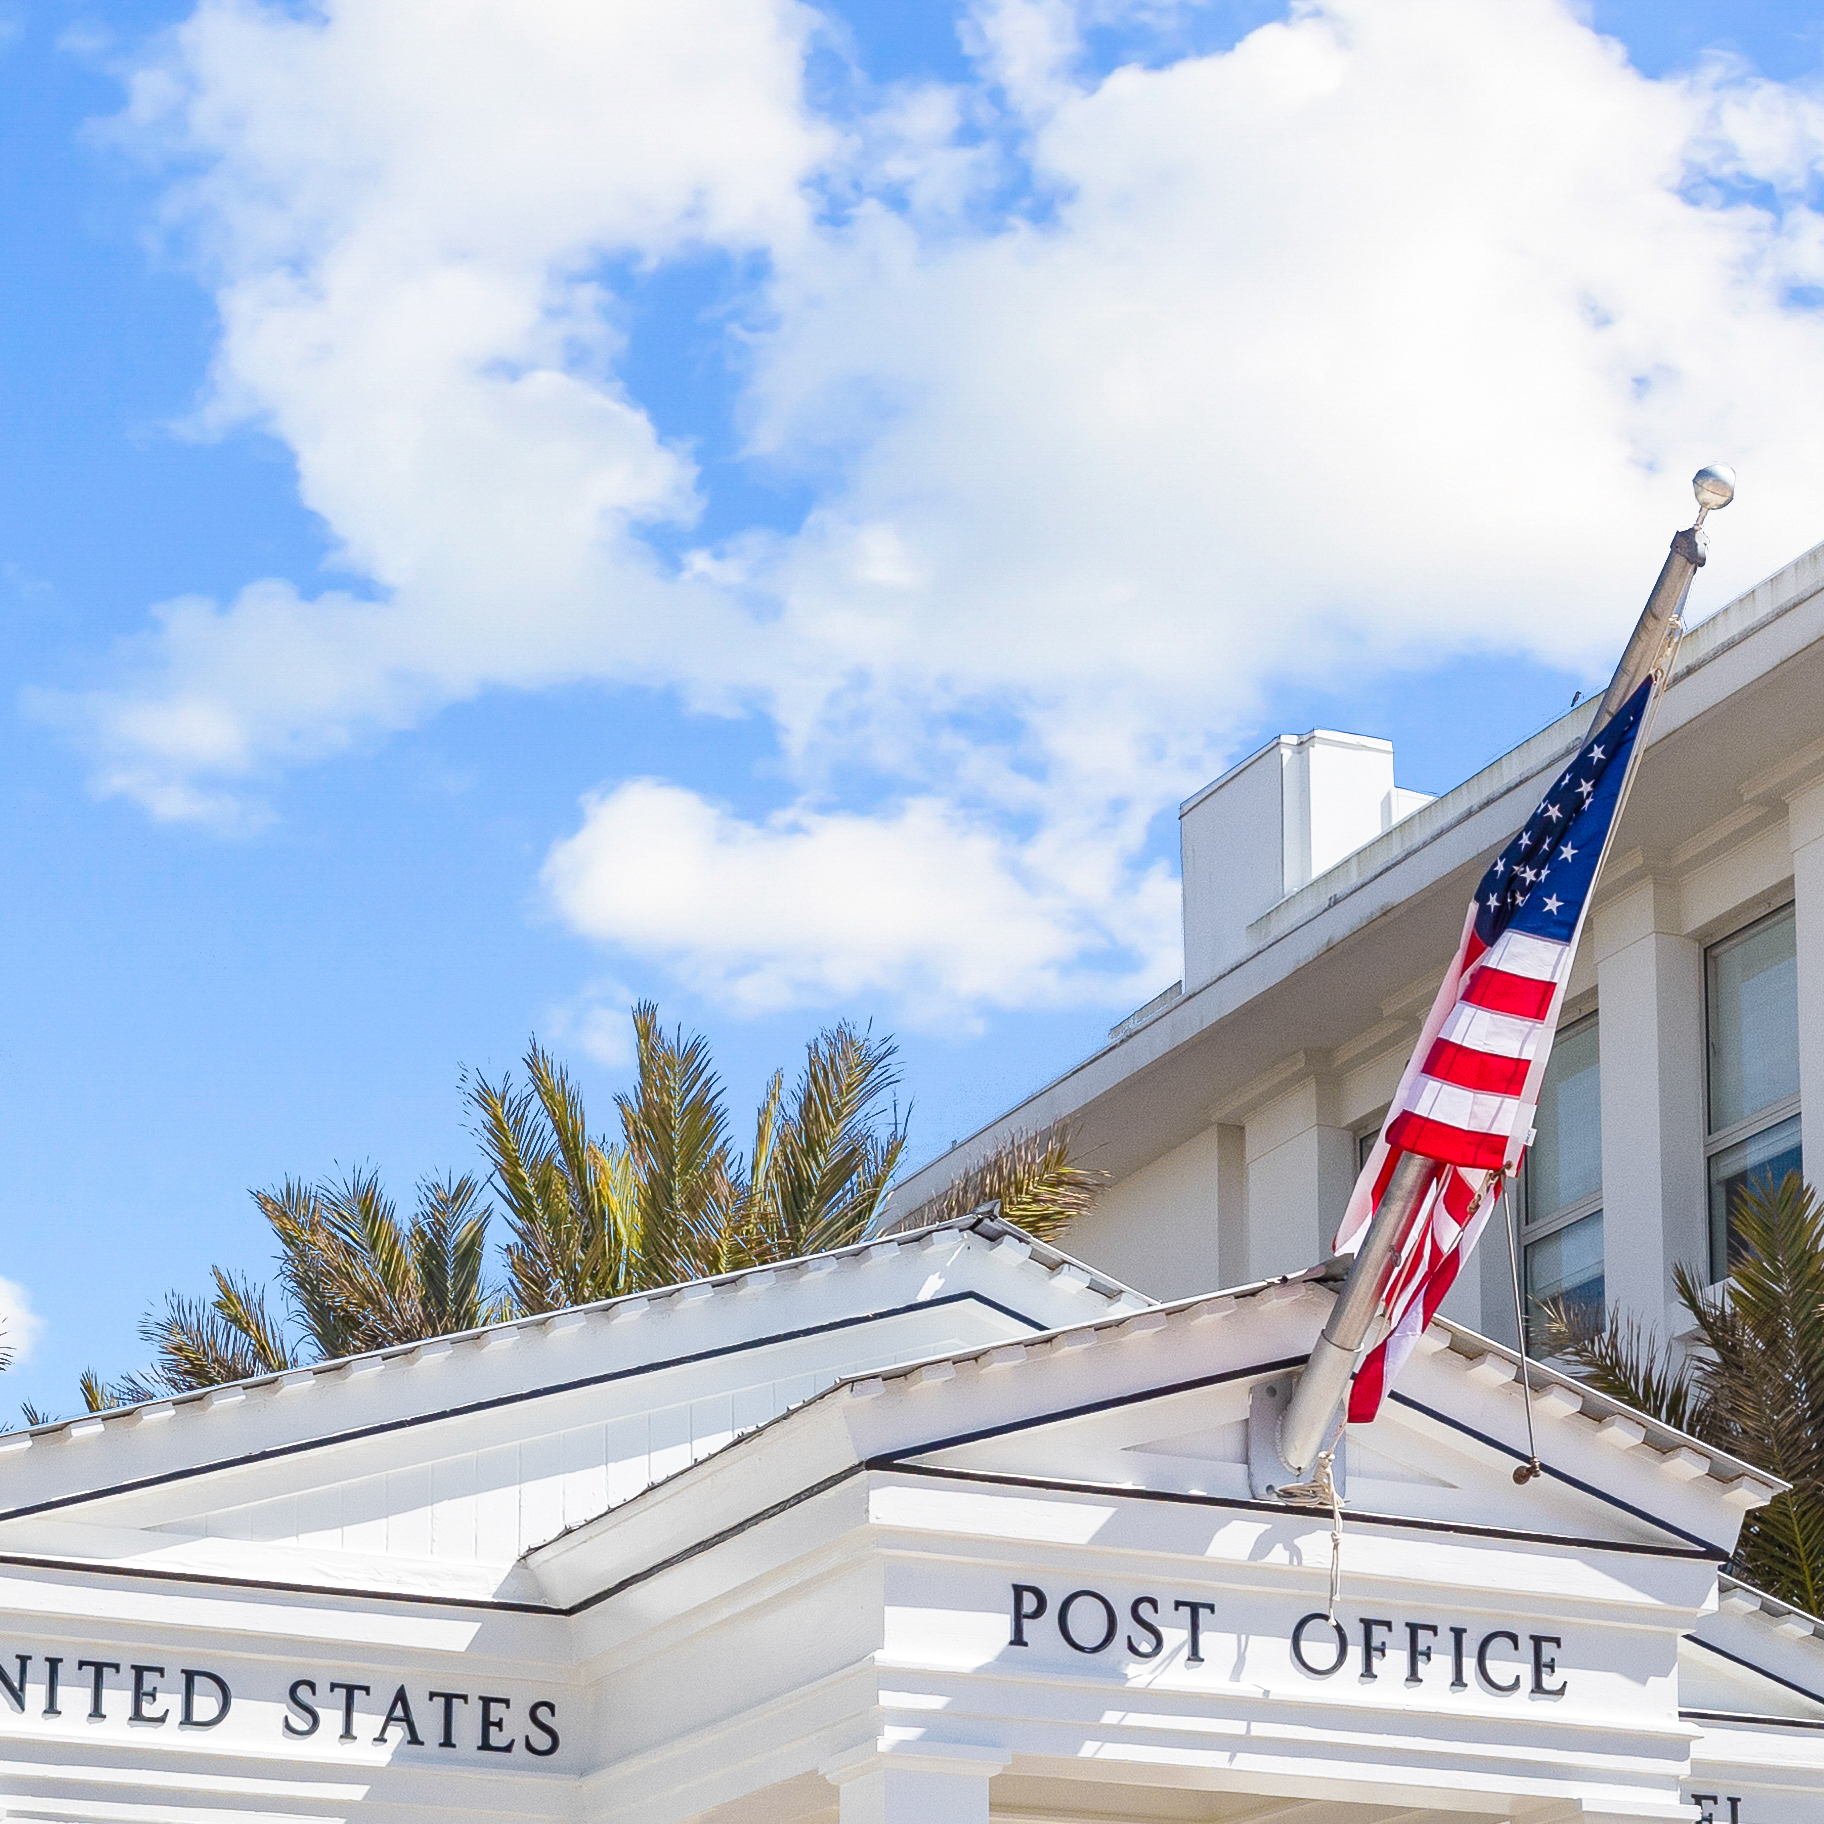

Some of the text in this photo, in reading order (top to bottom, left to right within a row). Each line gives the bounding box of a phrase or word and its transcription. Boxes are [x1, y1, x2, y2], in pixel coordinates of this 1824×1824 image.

[1008, 1583, 1569, 1697] POST OFFICE
[283, 1679, 561, 1758] STATES
